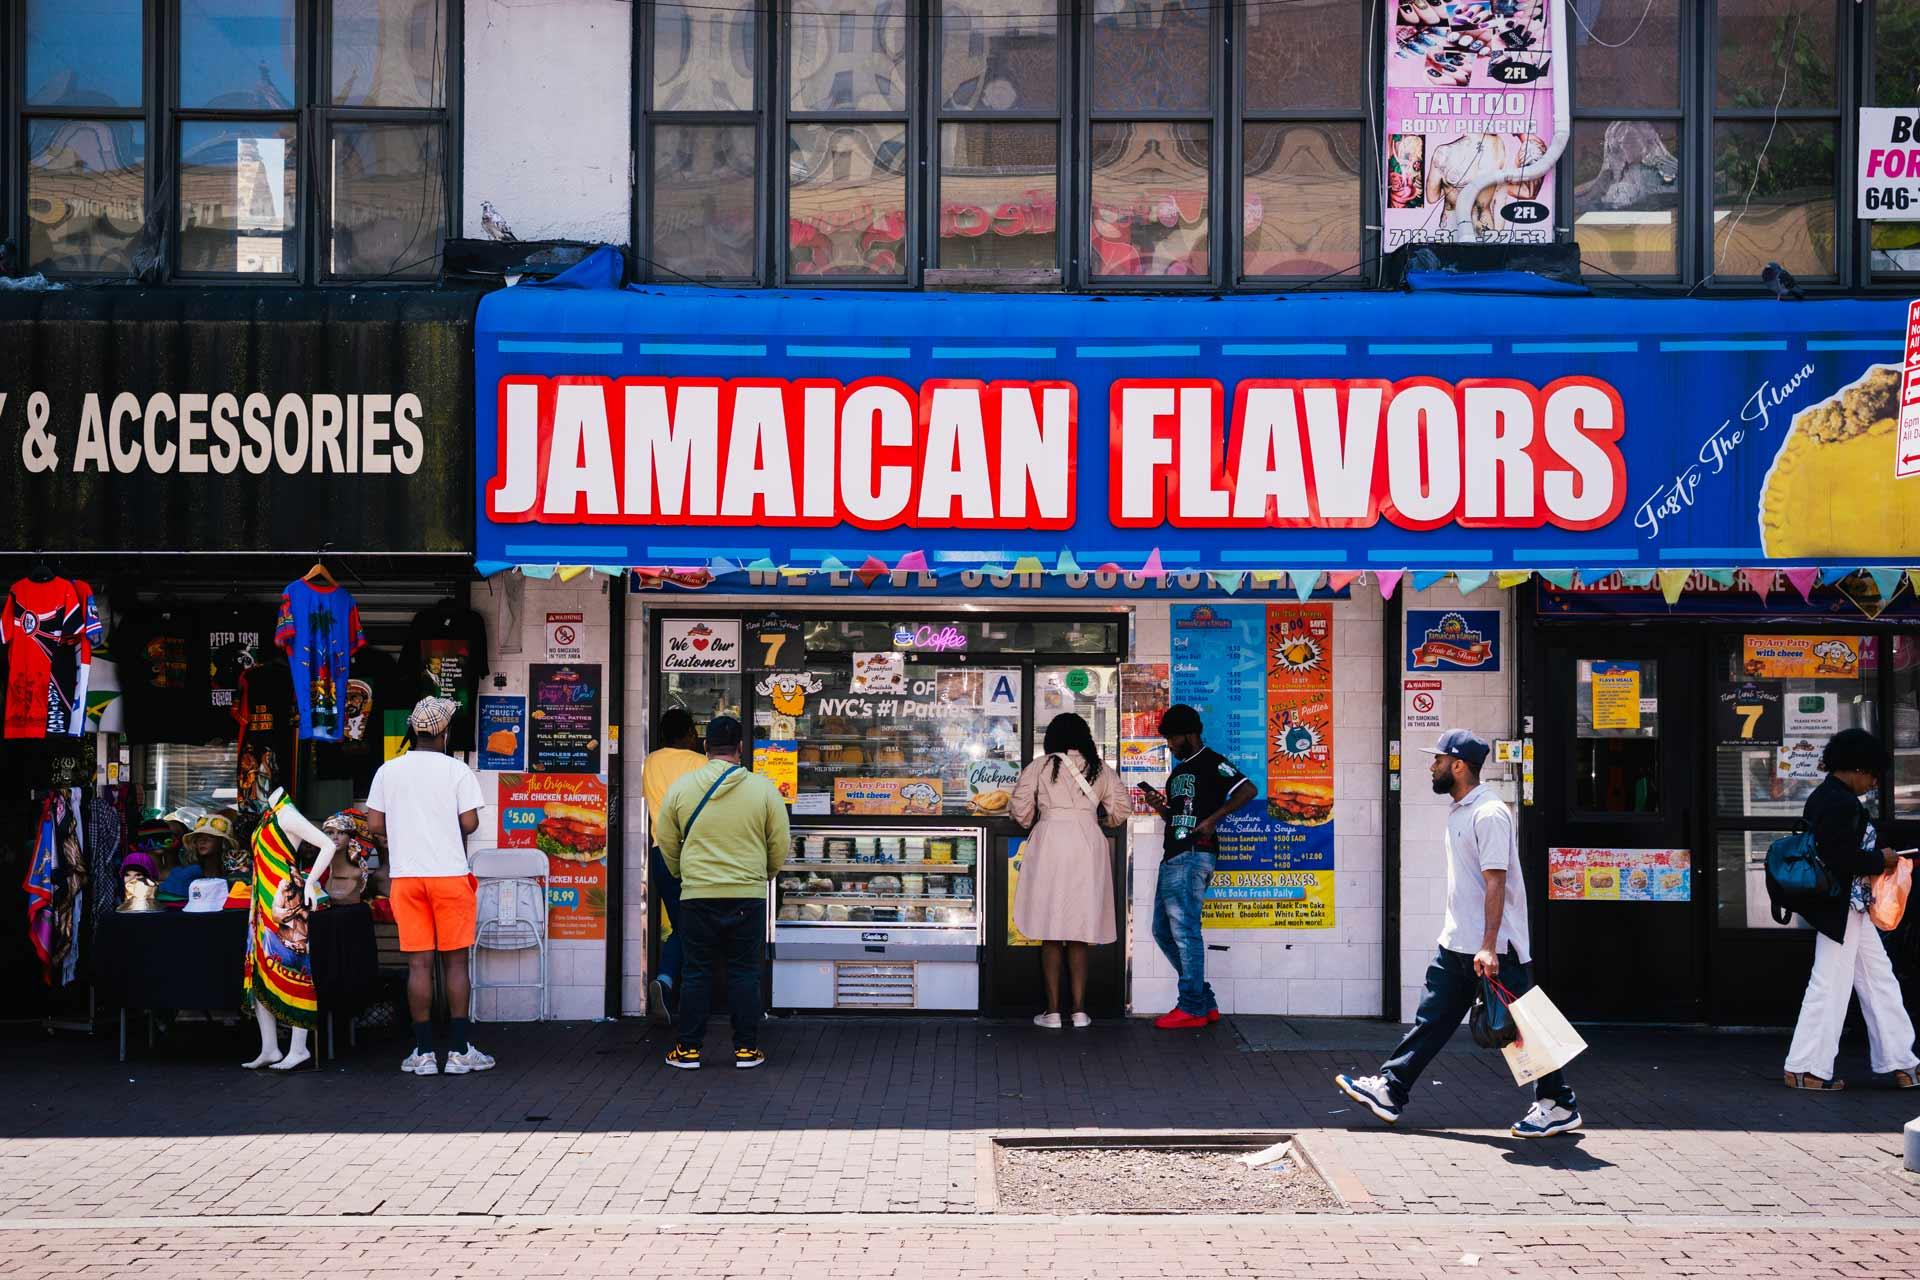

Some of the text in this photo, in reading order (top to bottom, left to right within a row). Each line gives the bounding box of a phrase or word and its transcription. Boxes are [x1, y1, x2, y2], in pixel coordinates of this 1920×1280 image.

[1504, 67, 1528, 79] 2FL
[1414, 92, 1526, 115] TATTOO
[1401, 119, 1537, 134] BODY PIERCING
[1513, 206, 1537, 219] 2FL
[21, 391, 424, 474] & ACCESSORIES
[494, 383, 1614, 522] JAMAICAN FLAVORS
[1634, 363, 1815, 539] Taste The Flava
[209, 631, 259, 647] PETER TOSH
[669, 637, 735, 652] We Our
[914, 625, 967, 652] Coffee
[1747, 639, 1811, 649] Try Any Patty
[1756, 648, 1804, 658] with cheese
[665, 654, 737, 668] Customers
[912, 679, 936, 696] OF
[991, 676, 1015, 703] A
[489, 709, 515, 717] CRUST
[818, 698, 873, 717] NYC's
[876, 699, 899, 717] #1
[1787, 752, 1820, 760] Breakfast
[525, 774, 584, 795] The Original
[970, 766, 1019, 789] Chickpea
[839, 781, 898, 790] Try Any Patty
[510, 792, 529, 801] JERK
[530, 793, 561, 802] CHICKEN
[846, 791, 865, 799] with
[508, 809, 536, 824] $5.00
[1225, 814, 1261, 826] Signature
[1239, 854, 1253, 862] Only
[574, 875, 599, 884] SALAD
[1214, 889, 1294, 899] We Bake Fresh Daily
